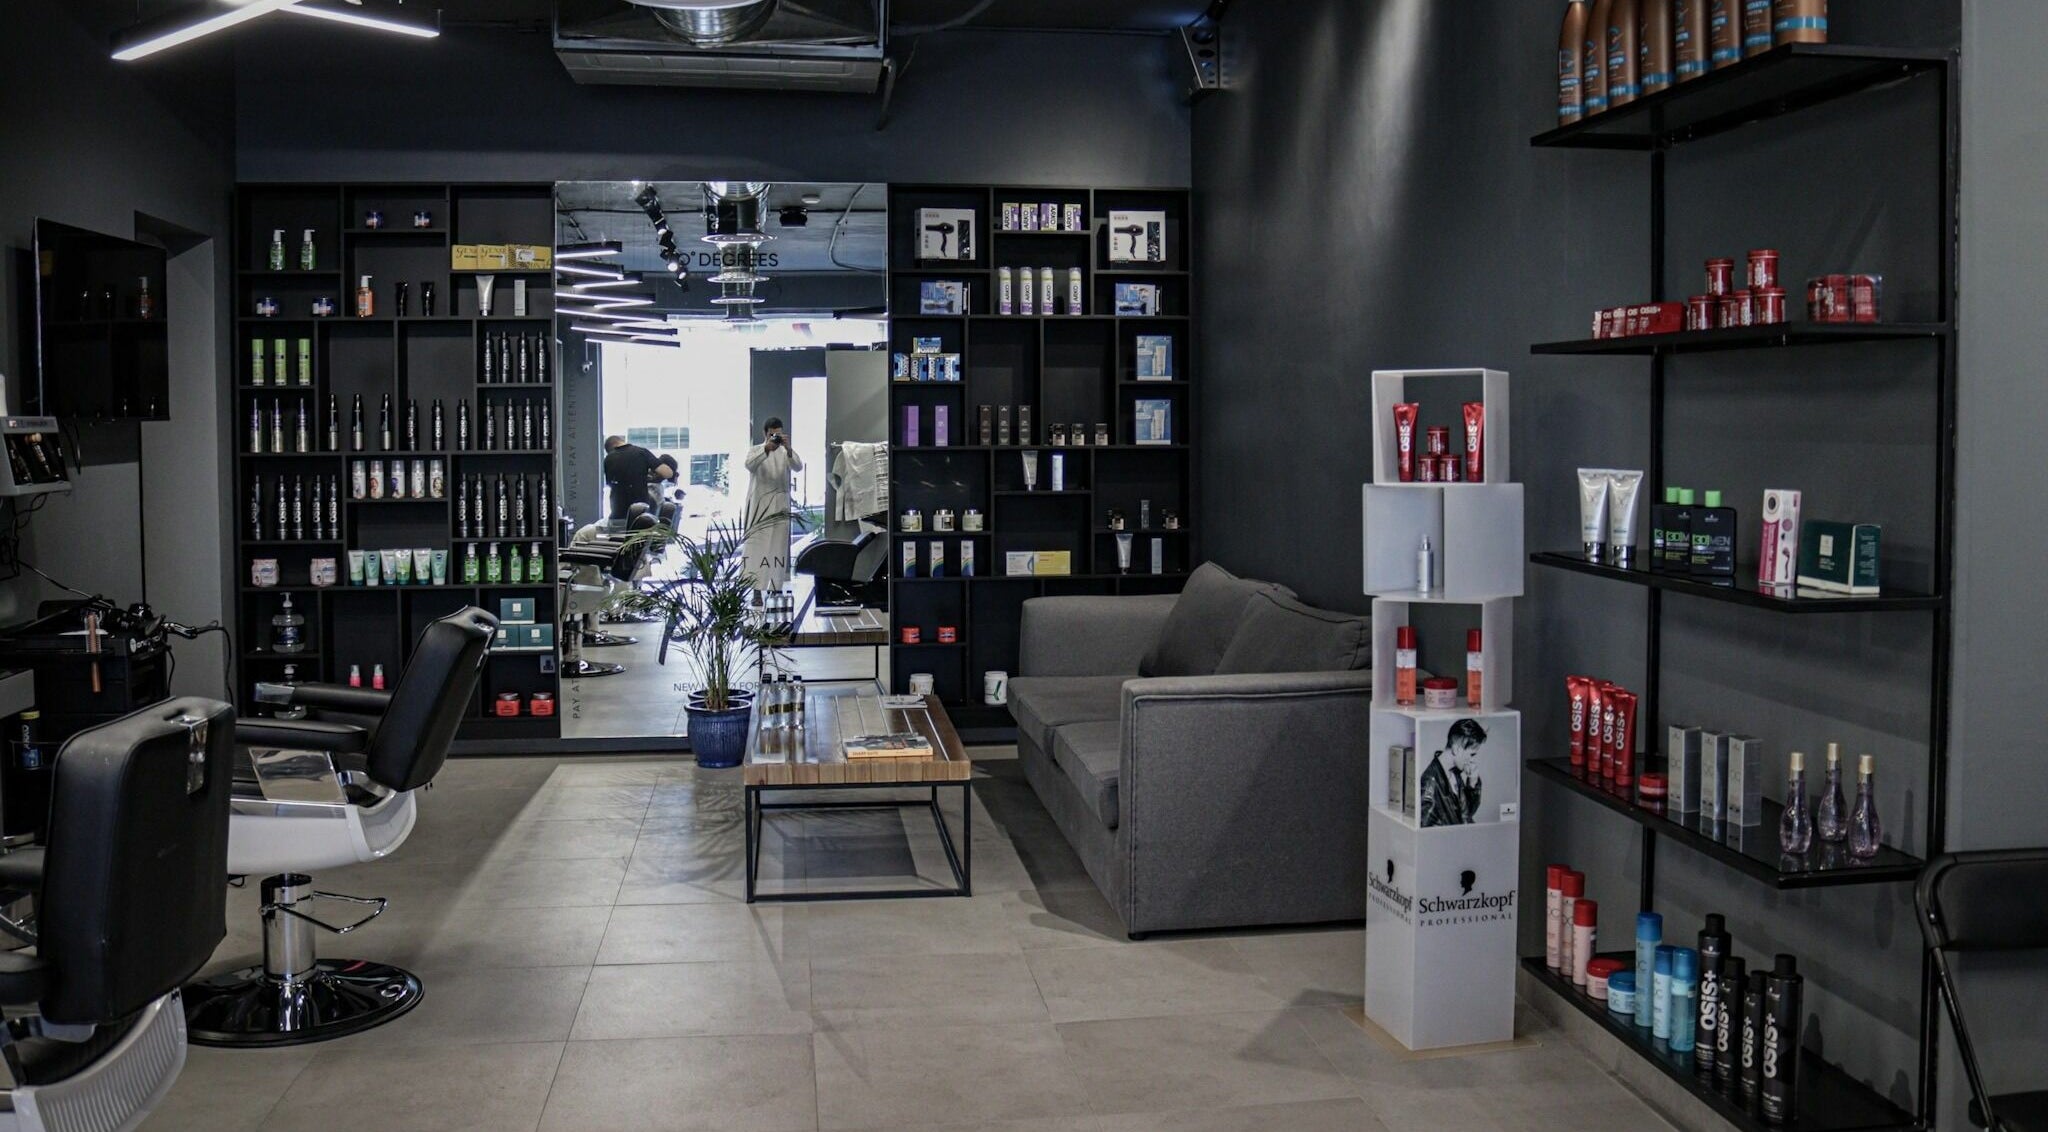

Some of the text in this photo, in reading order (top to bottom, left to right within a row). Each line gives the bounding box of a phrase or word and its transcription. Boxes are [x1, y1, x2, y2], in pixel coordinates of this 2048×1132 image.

[699, 252, 779, 267] DEGREES
[567, 374, 577, 439] ATTENTIO
[1400, 420, 1411, 453] OSIS+
[1467, 419, 1478, 452] OSIS+
[572, 697, 581, 719] PAY
[1571, 694, 1582, 732] OSIS+
[1588, 698, 1600, 737] OSIS+
[1603, 704, 1615, 743] OSIS+
[1615, 710, 1626, 750] OSIS+
[1368, 871, 1413, 914] Schwarzkopf
[1418, 890, 1516, 914] Schwarzkopf
[1420, 913, 1512, 927] PROFESSIONAL
[1700, 970, 1719, 1031] OSIS+
[1717, 1001, 1730, 1052] OSIS+
[1741, 1016, 1754, 1069] OSIS+
[1763, 1012, 1779, 1079] OSIS+
